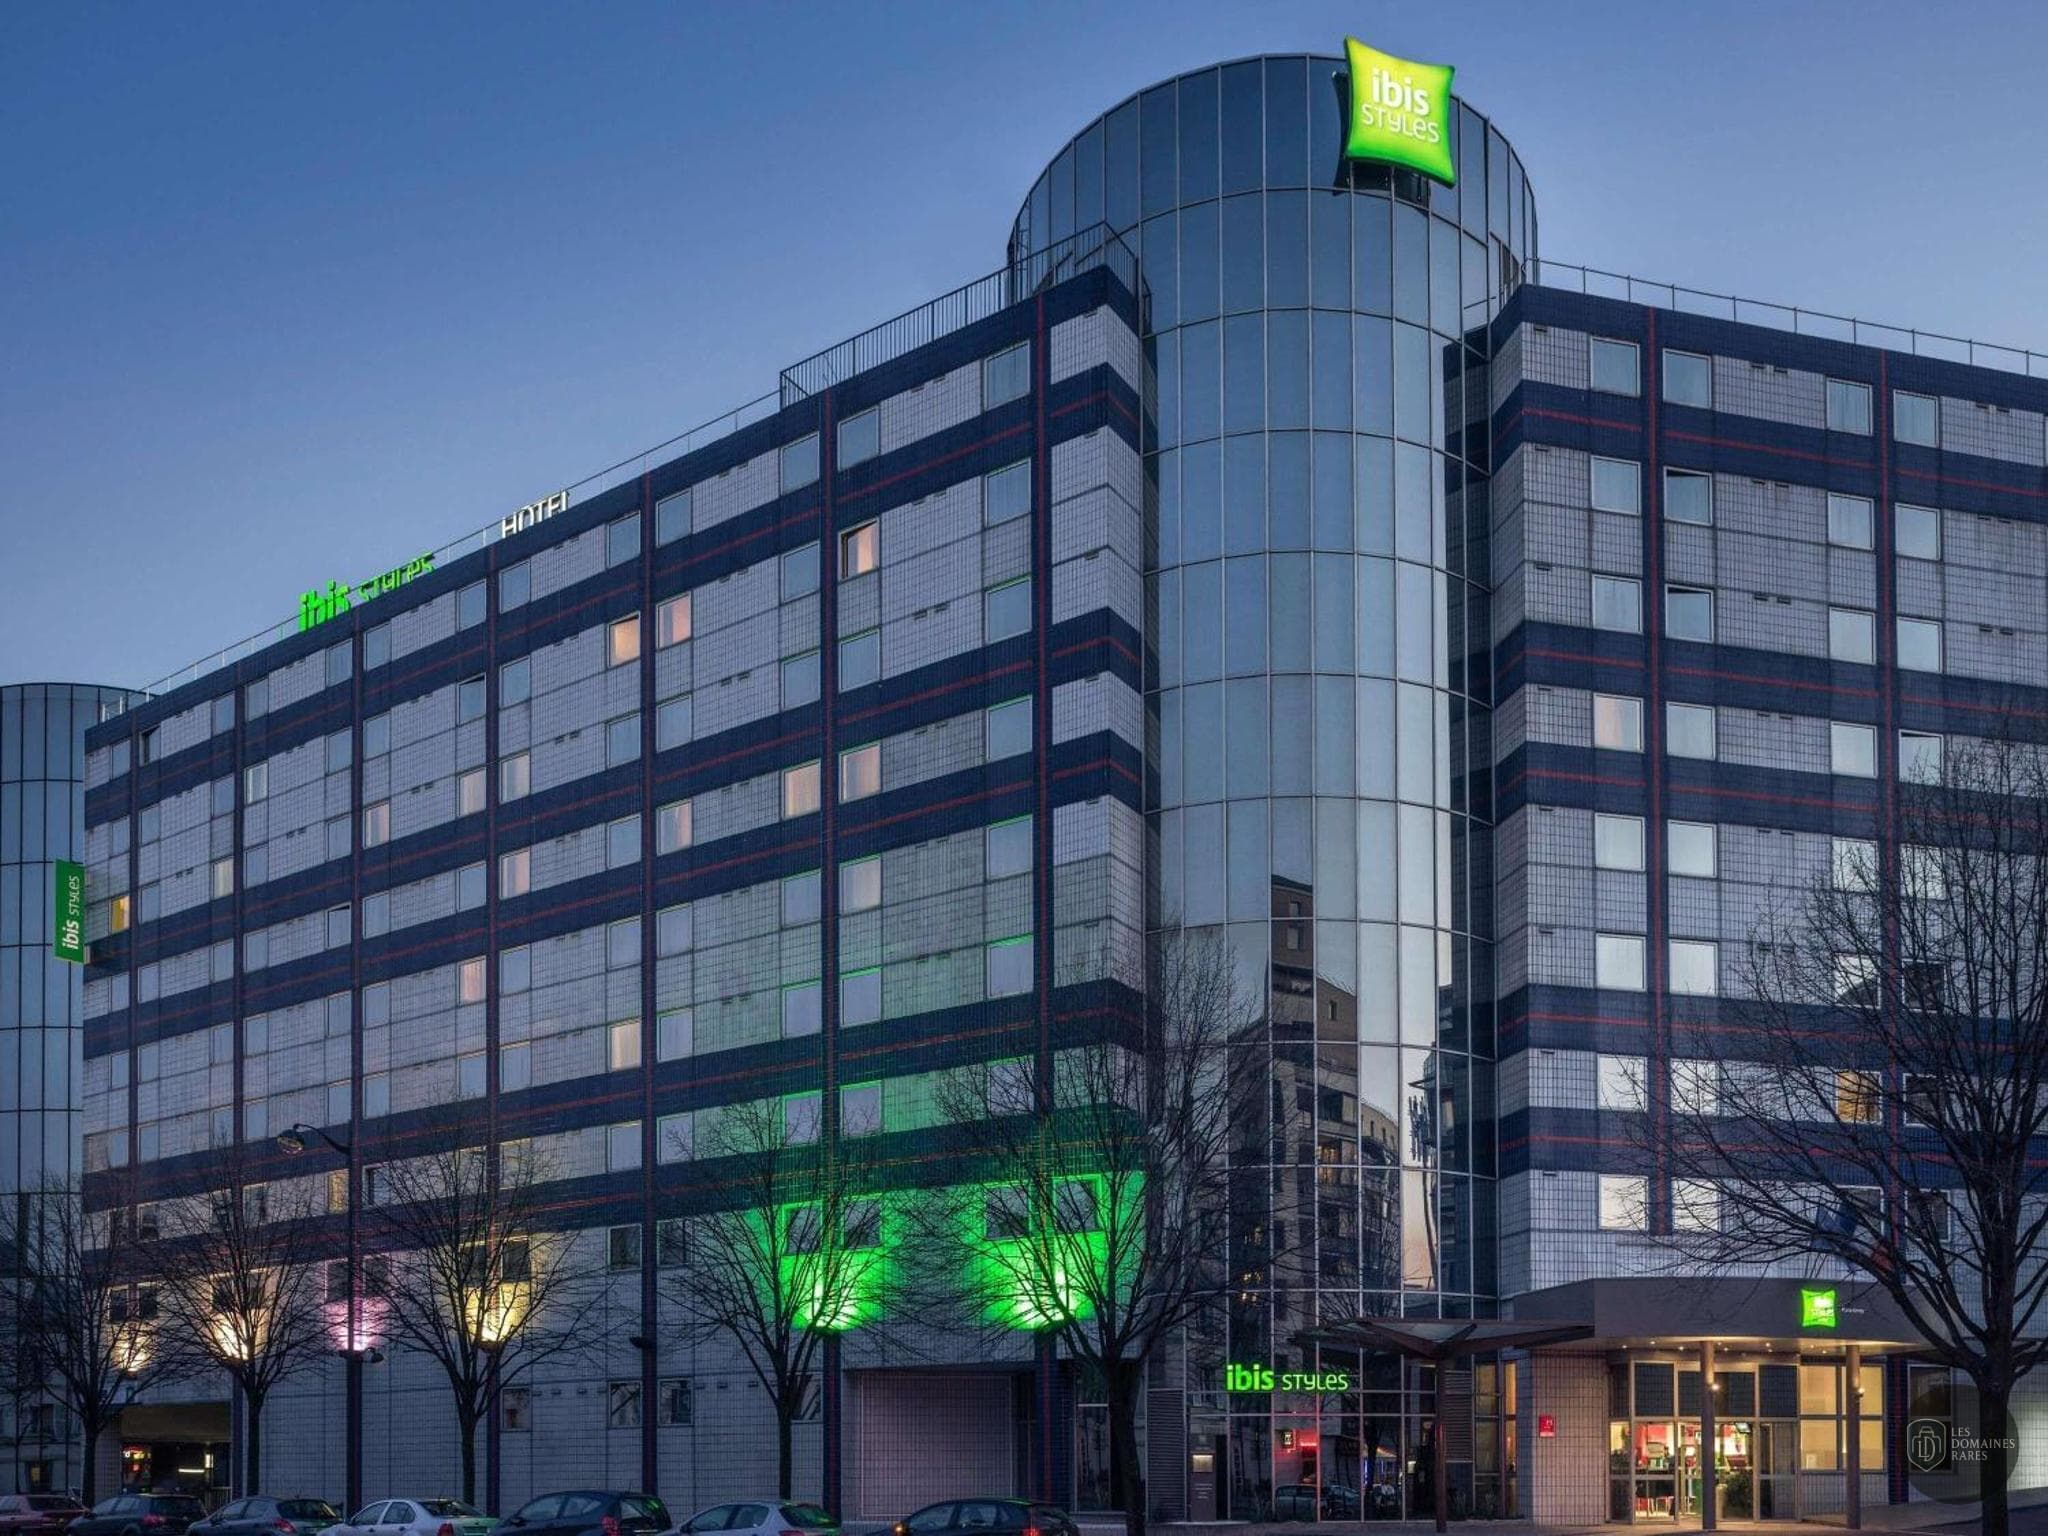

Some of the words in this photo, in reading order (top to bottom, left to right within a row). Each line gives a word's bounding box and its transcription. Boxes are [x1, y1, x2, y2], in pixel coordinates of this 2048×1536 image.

[1371, 67, 1430, 116] ibis
[62, 919, 79, 950] ibis
[1226, 1364, 1275, 1391] ibis
